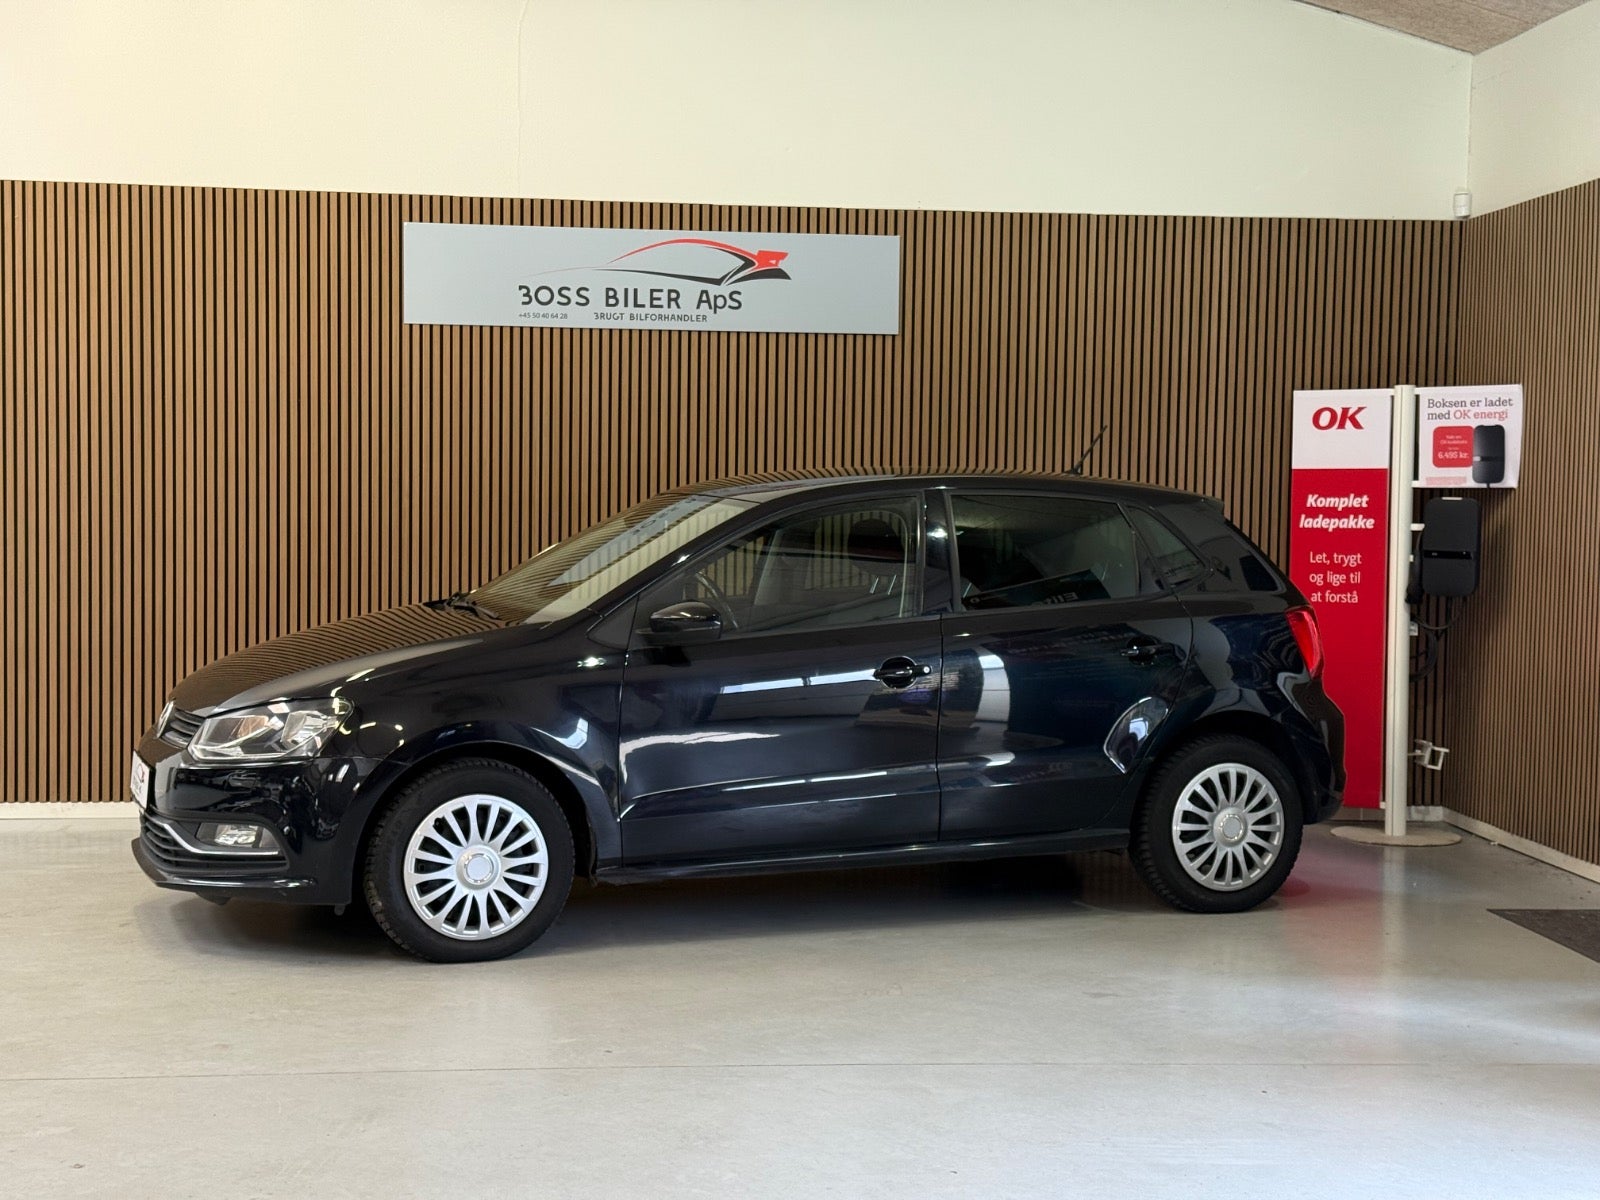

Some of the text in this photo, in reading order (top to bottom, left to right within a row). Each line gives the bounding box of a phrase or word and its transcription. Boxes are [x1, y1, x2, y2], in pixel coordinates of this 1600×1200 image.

[605, 287, 682, 309] BILER
[696, 289, 742, 314] ApS
[541, 312, 550, 320] 40
[550, 312, 559, 320] 64
[629, 313, 708, 322] BILFORHANDLER
[1427, 396, 1514, 409] Boksen er ladet
[1311, 406, 1367, 431] OK
[1427, 408, 1509, 421] med OK energi
[1306, 493, 1369, 512] Komplet
[1299, 514, 1375, 533] ladepakke
[1309, 551, 1362, 568] Let, trygt
[1309, 570, 1361, 587] og lige til
[1310, 590, 1359, 604] at forstå
